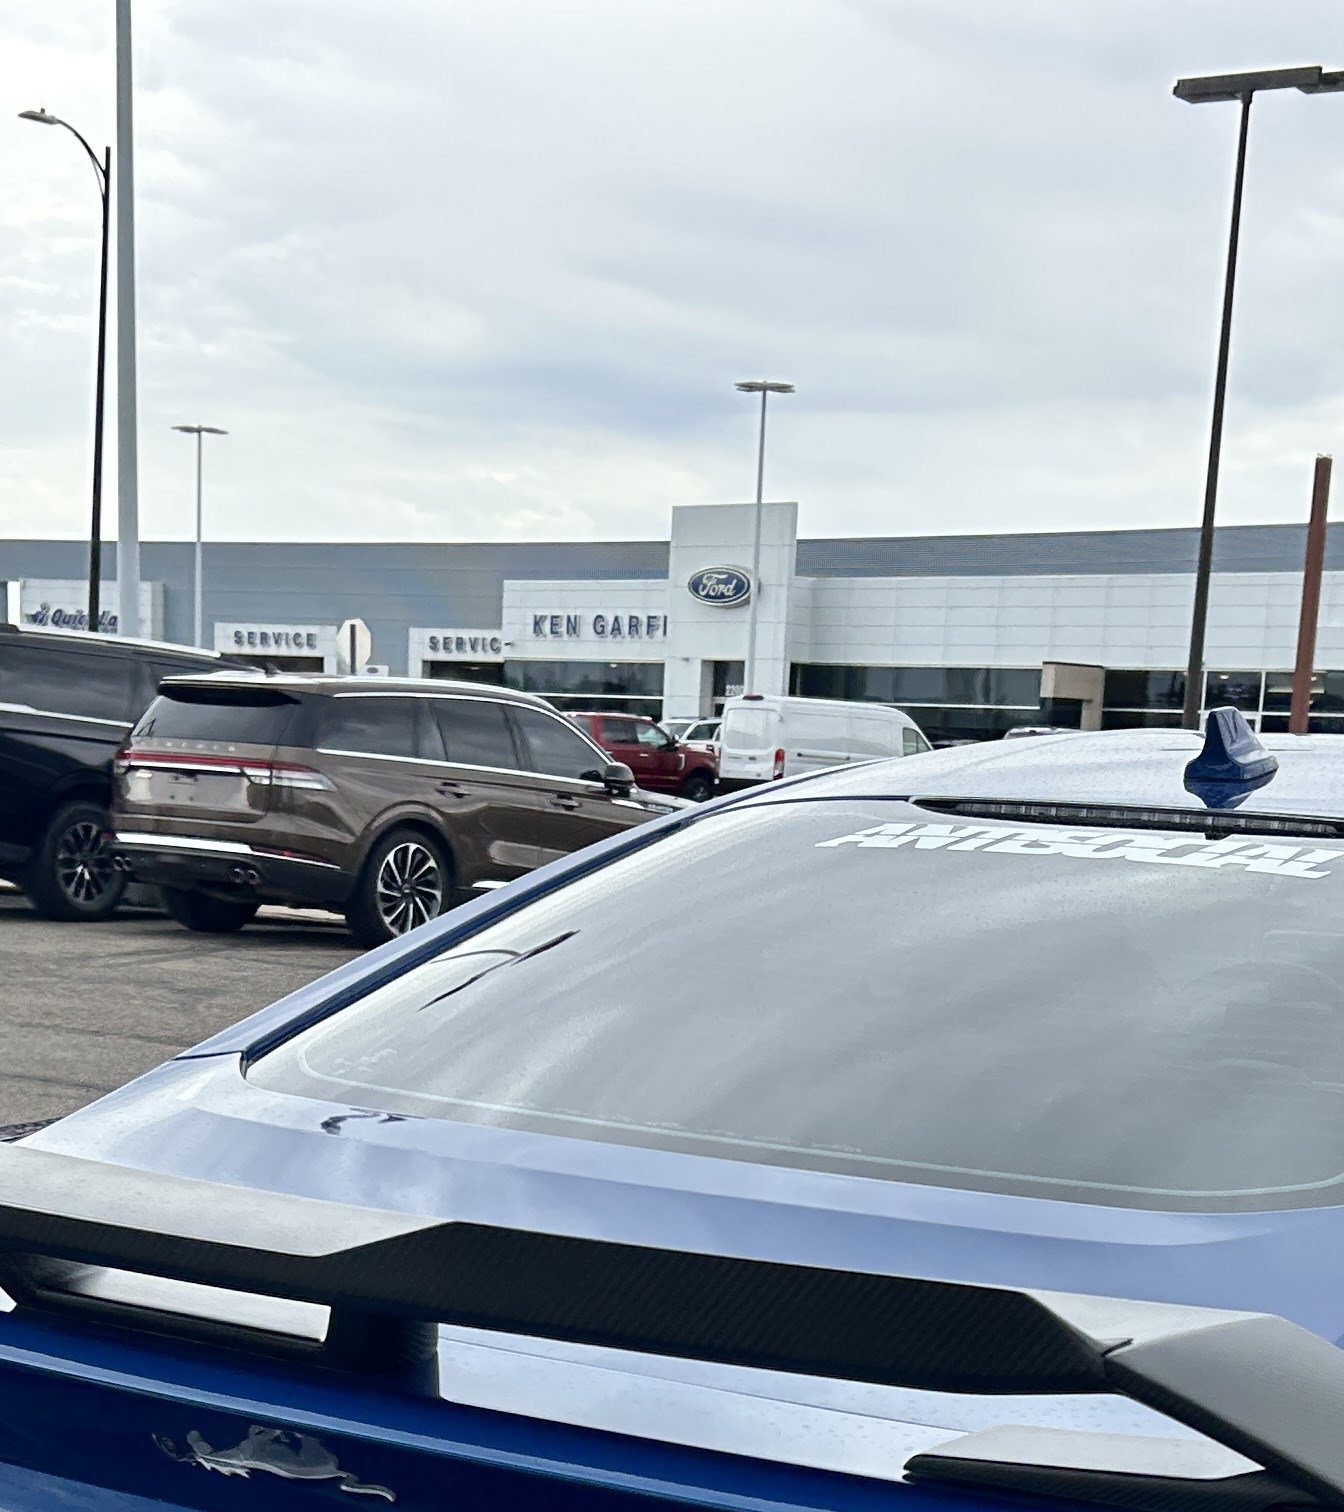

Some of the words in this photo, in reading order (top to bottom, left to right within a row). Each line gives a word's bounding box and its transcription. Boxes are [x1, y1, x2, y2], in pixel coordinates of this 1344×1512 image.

[698, 574, 738, 597] Ford
[51, 608, 90, 626] Quic
[532, 614, 579, 636] KEN
[233, 630, 318, 649] SERVICE
[428, 636, 505, 653] SERVIC
